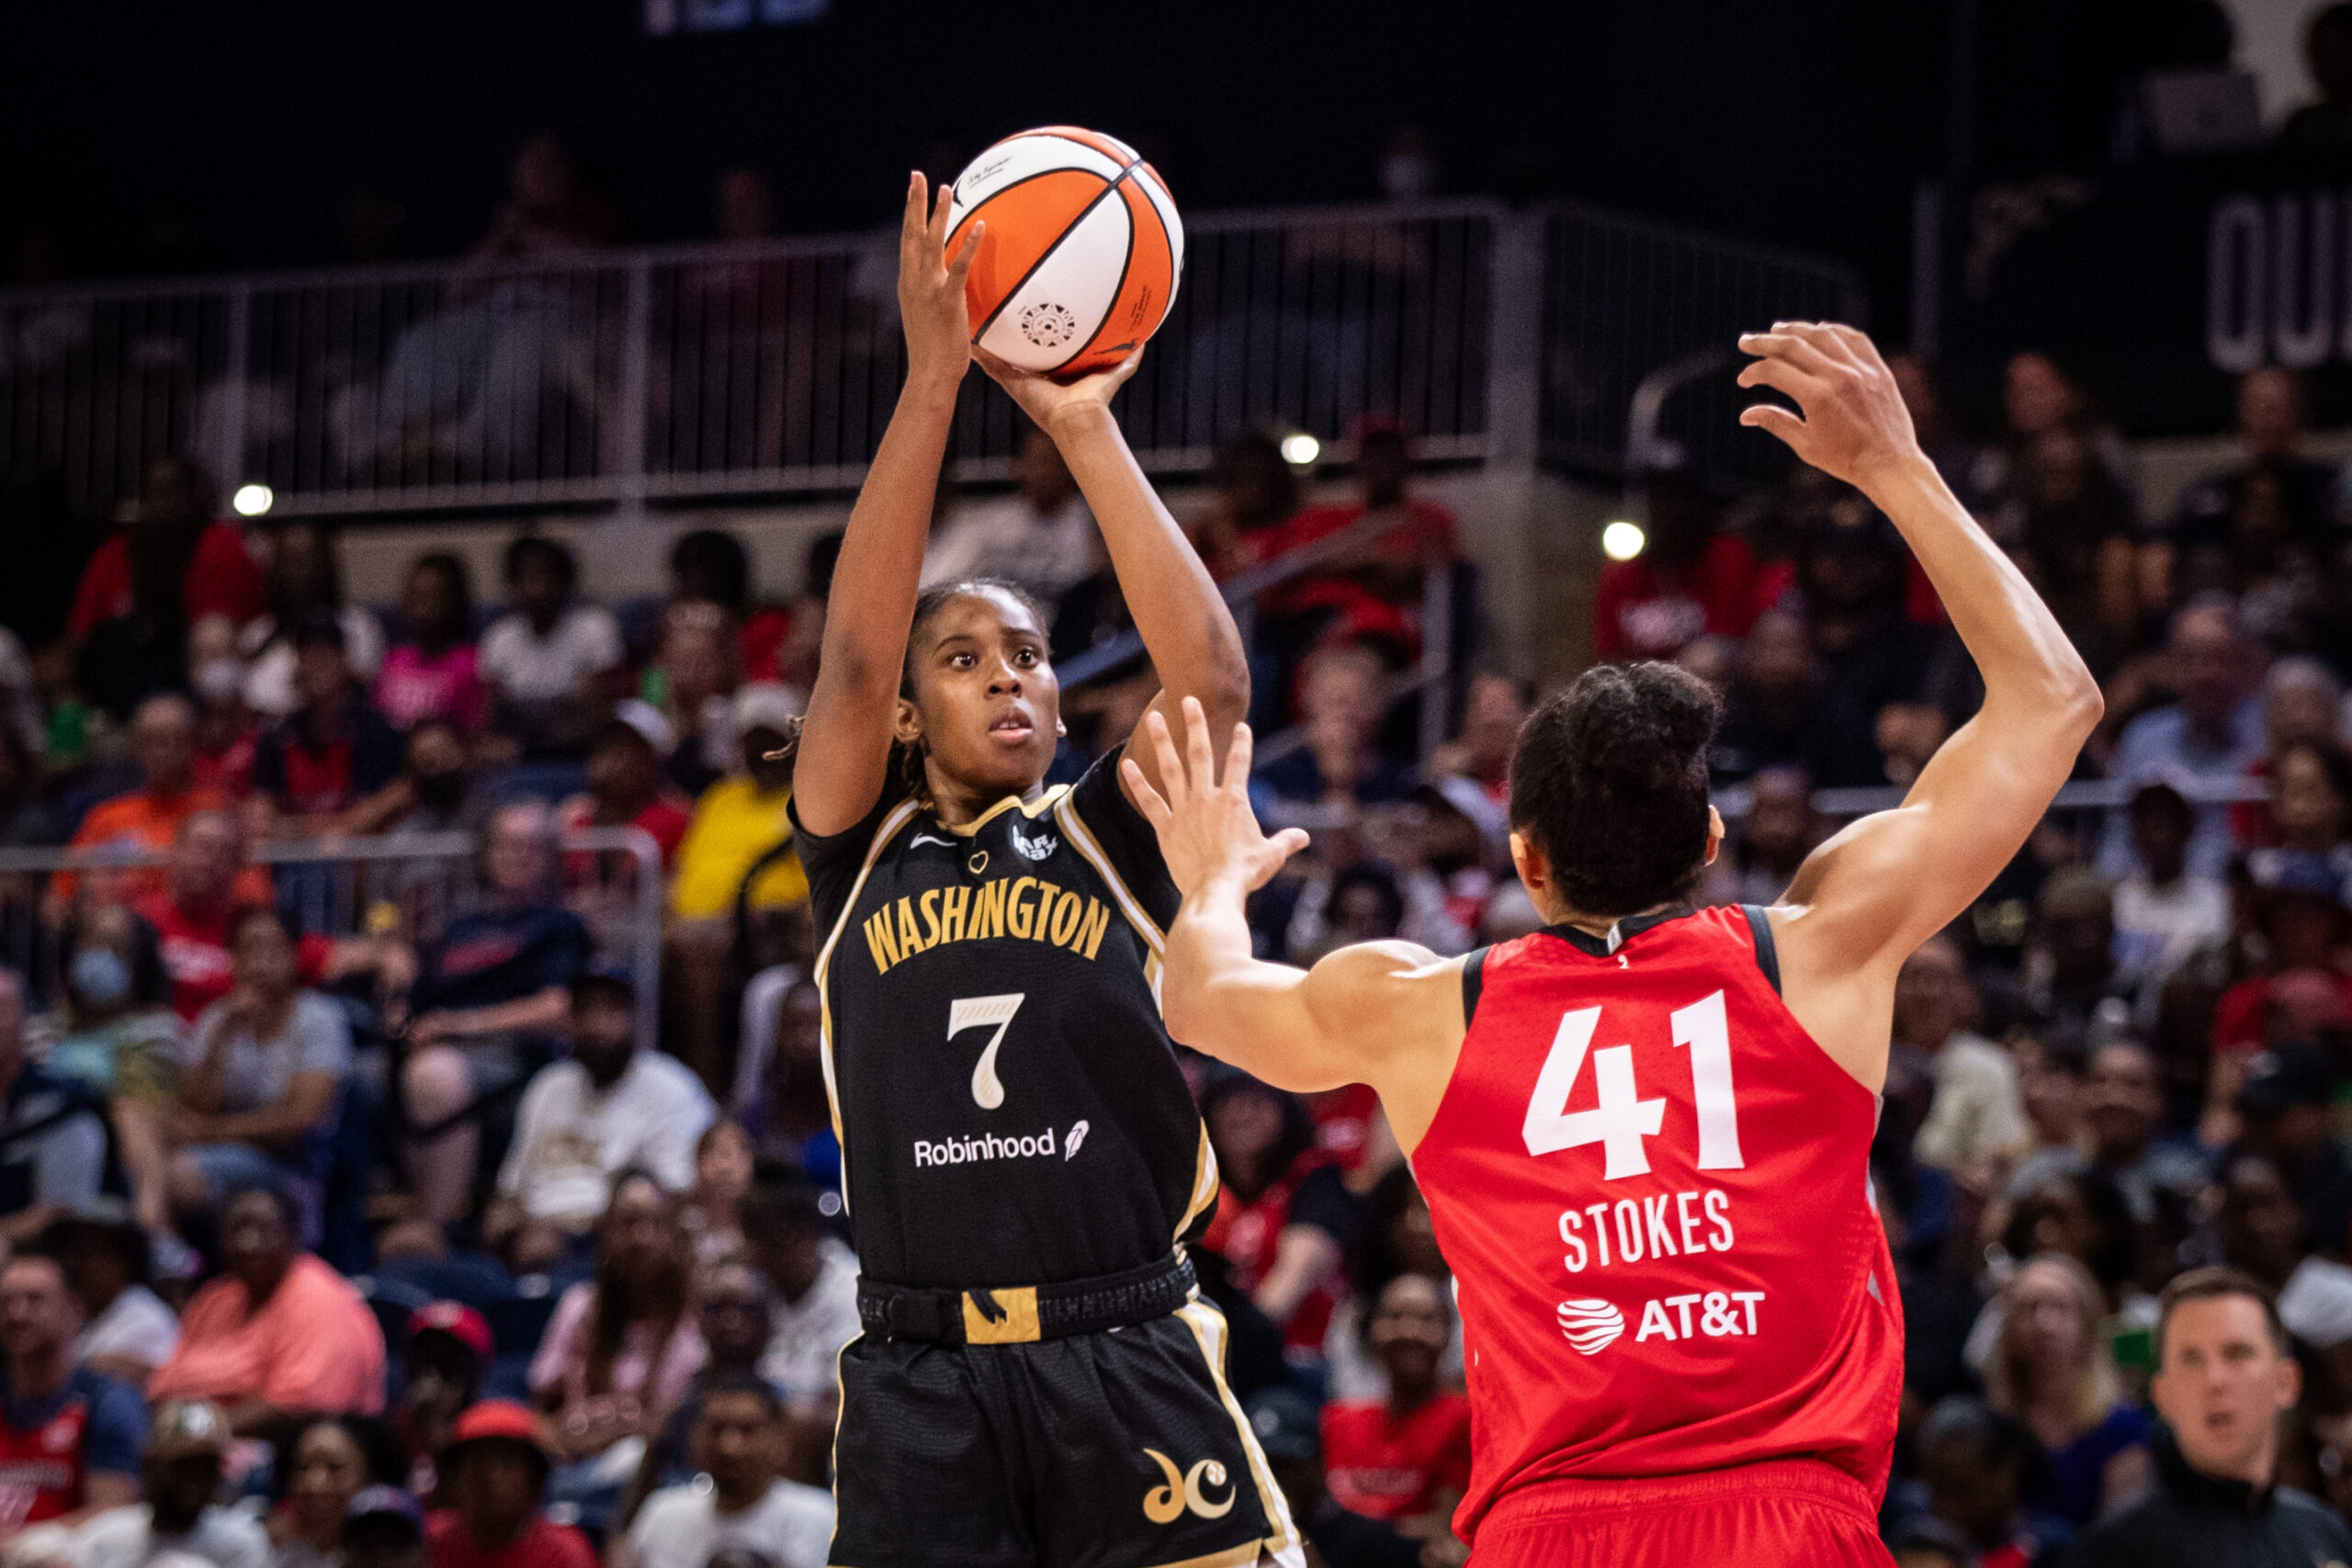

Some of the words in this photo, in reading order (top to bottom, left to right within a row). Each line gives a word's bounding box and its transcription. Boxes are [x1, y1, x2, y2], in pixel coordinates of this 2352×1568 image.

[863, 876, 1110, 975] WASHINGTON
[947, 993, 1025, 1110] 7
[1521, 989, 1745, 1181] 41
[913, 1128, 1056, 1168] Robinhood
[1558, 1190, 1735, 1273] STOKES
[1634, 1291, 1766, 1343] AT&T
